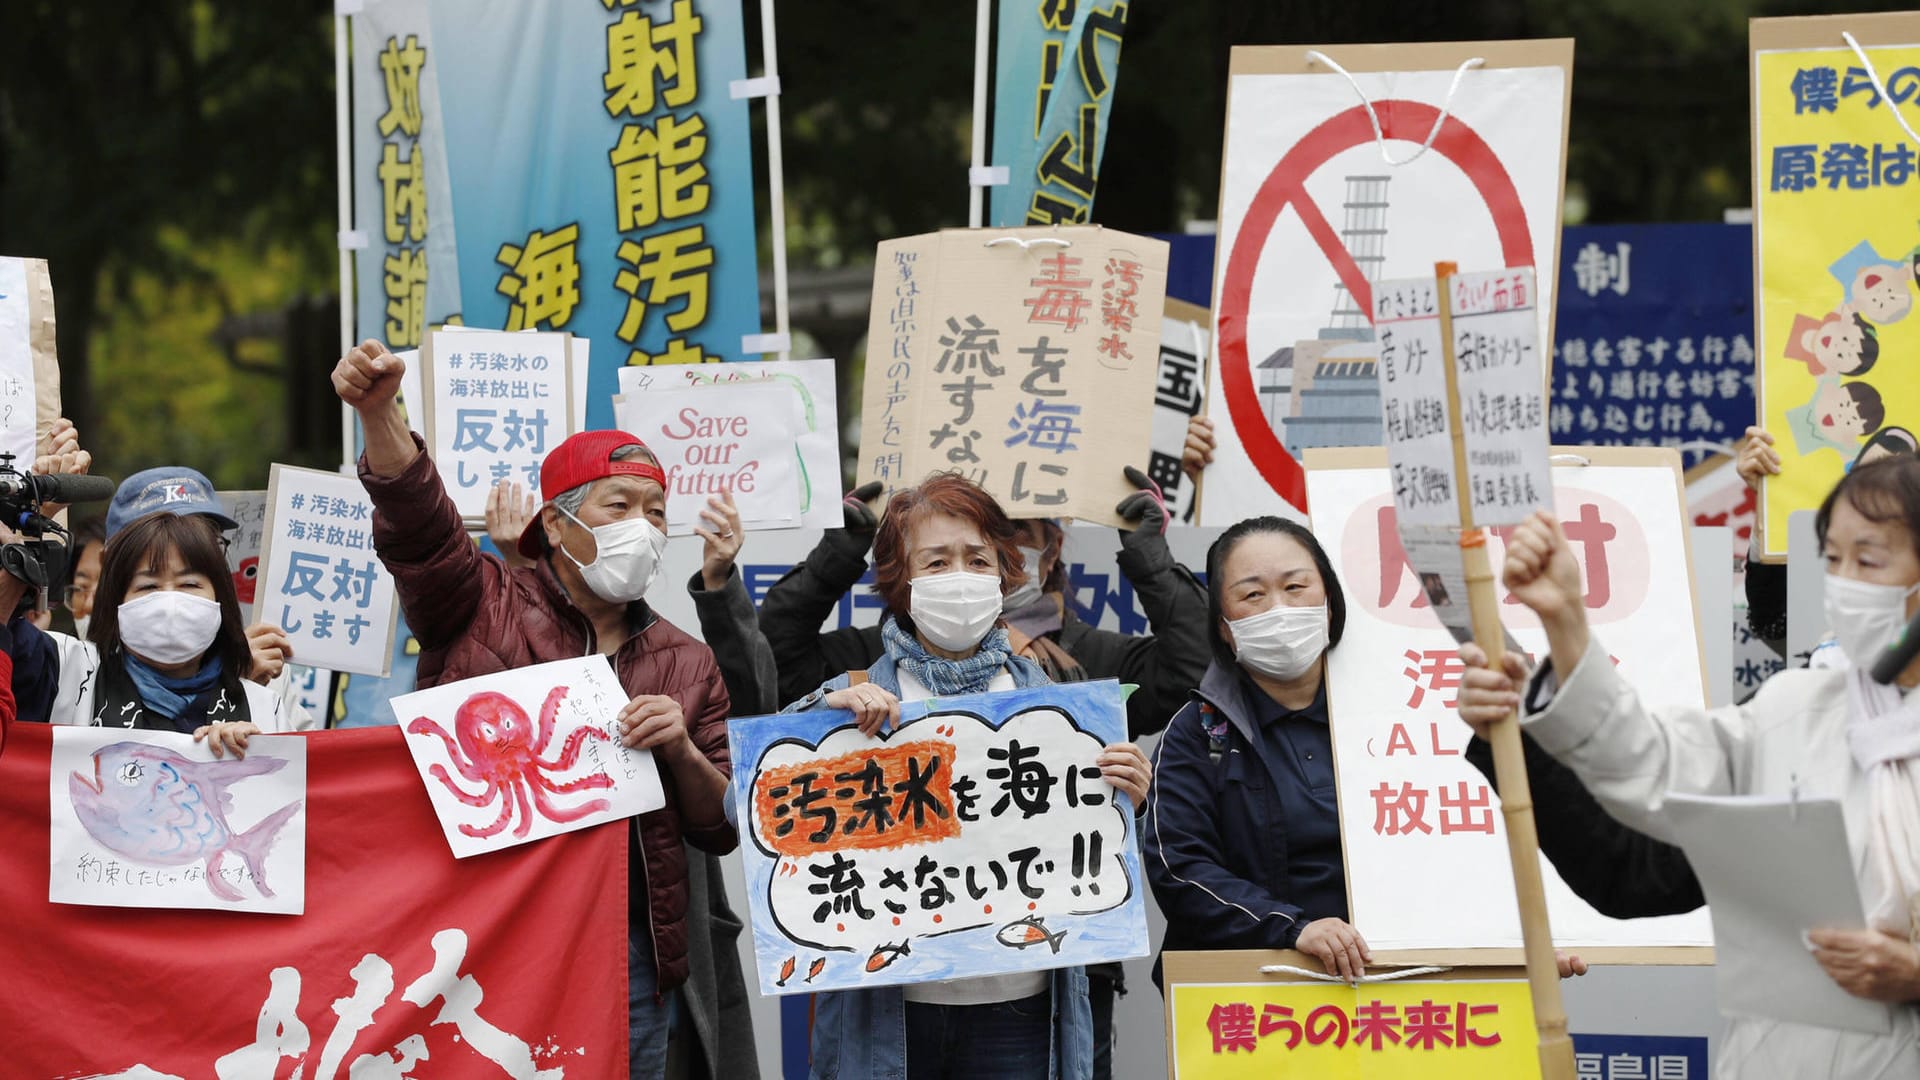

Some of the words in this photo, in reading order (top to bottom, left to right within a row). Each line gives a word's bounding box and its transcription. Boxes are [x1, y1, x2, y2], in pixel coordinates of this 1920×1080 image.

[603, 0, 718, 364] 射能汚
[1771, 142, 1920, 192] 原発は
[449, 352, 548, 371] #汚染水の
[1003, 251, 1093, 505] 毒を海に
[449, 378, 549, 399] 海洋放出に
[452, 408, 549, 454] 反対
[661, 407, 749, 441] Save
[684, 442, 740, 466] our
[663, 460, 760, 502] future
[290, 493, 374, 521] #汚染水
[281, 550, 378, 609] 反対
[281, 604, 371, 646] します
[769, 739, 1105, 844] 汚染水を海に
[807, 829, 1104, 924] 流さないで!!
[1206, 1000, 1502, 1053] 僕らの未来に
[1576, 1052, 1689, 1080] 島県
